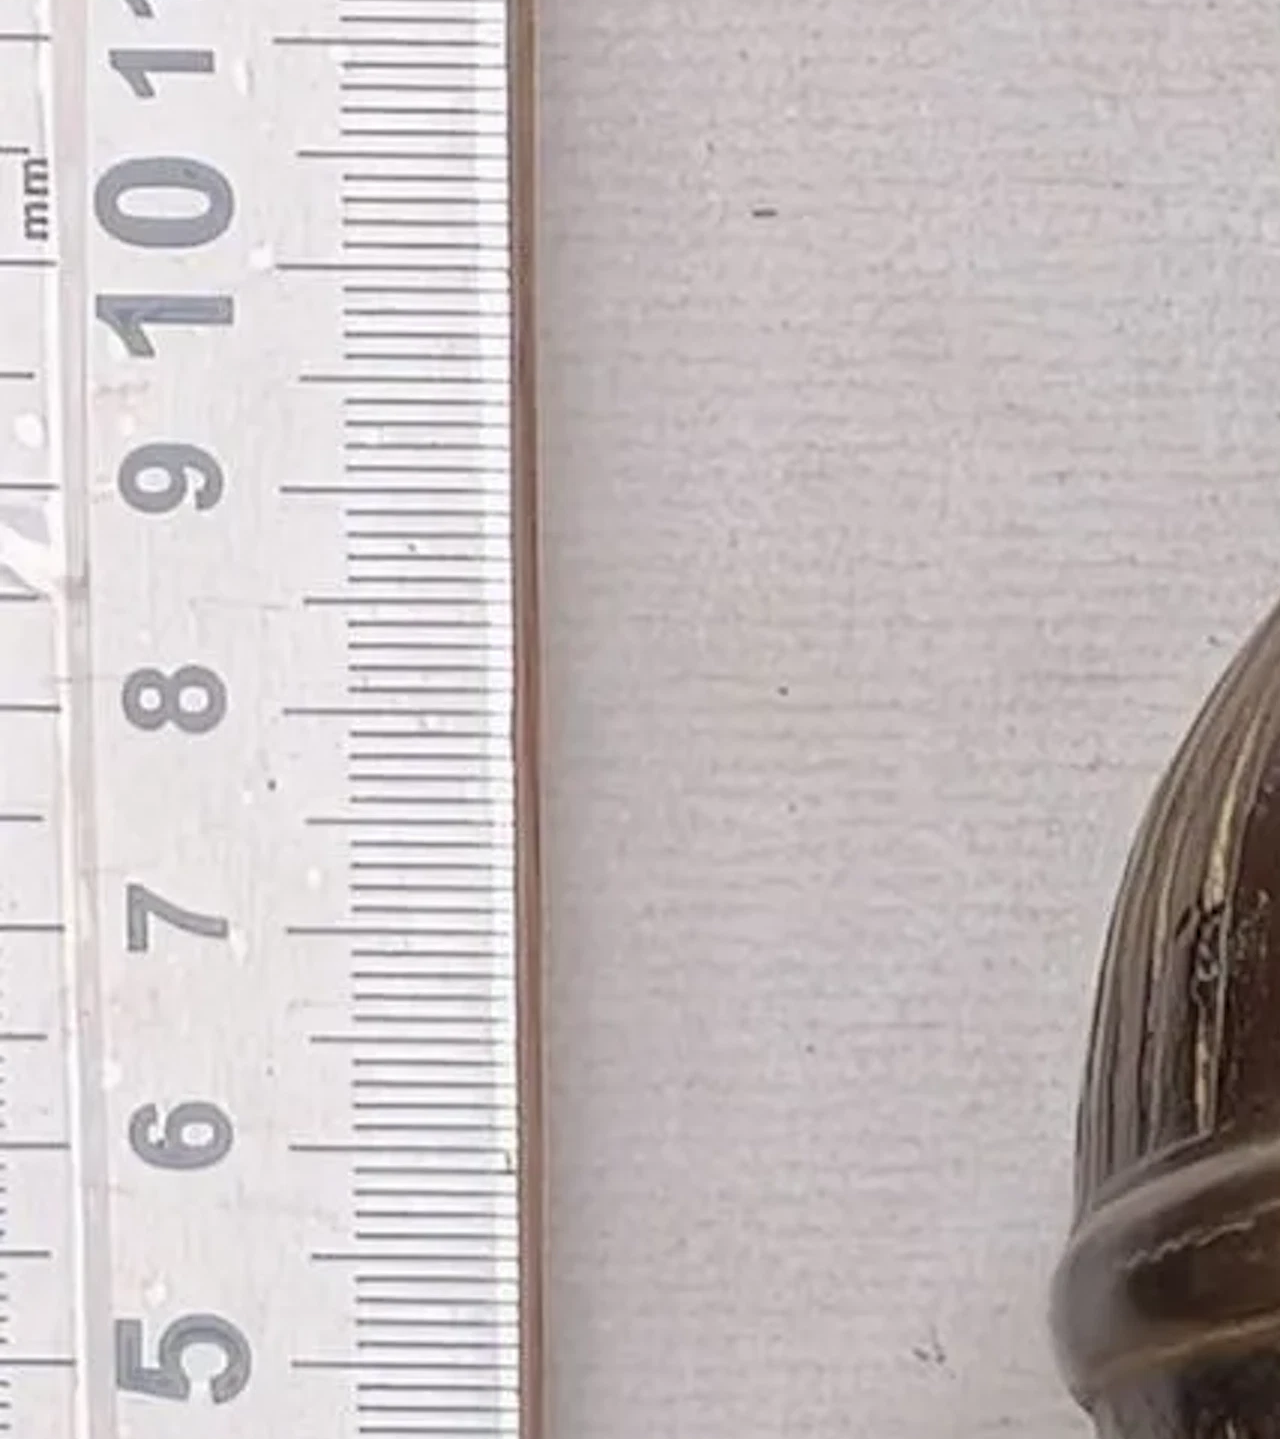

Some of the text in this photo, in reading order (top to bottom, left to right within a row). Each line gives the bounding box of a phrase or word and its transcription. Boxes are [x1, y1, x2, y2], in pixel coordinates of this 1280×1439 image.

[22, 157, 49, 242] mm
[93, 157, 235, 358] 10
[117, 443, 224, 514] 9
[121, 665, 227, 734] 8
[126, 883, 229, 953] 7
[128, 1101, 233, 1171] 6
[114, 1312, 251, 1405] 5
